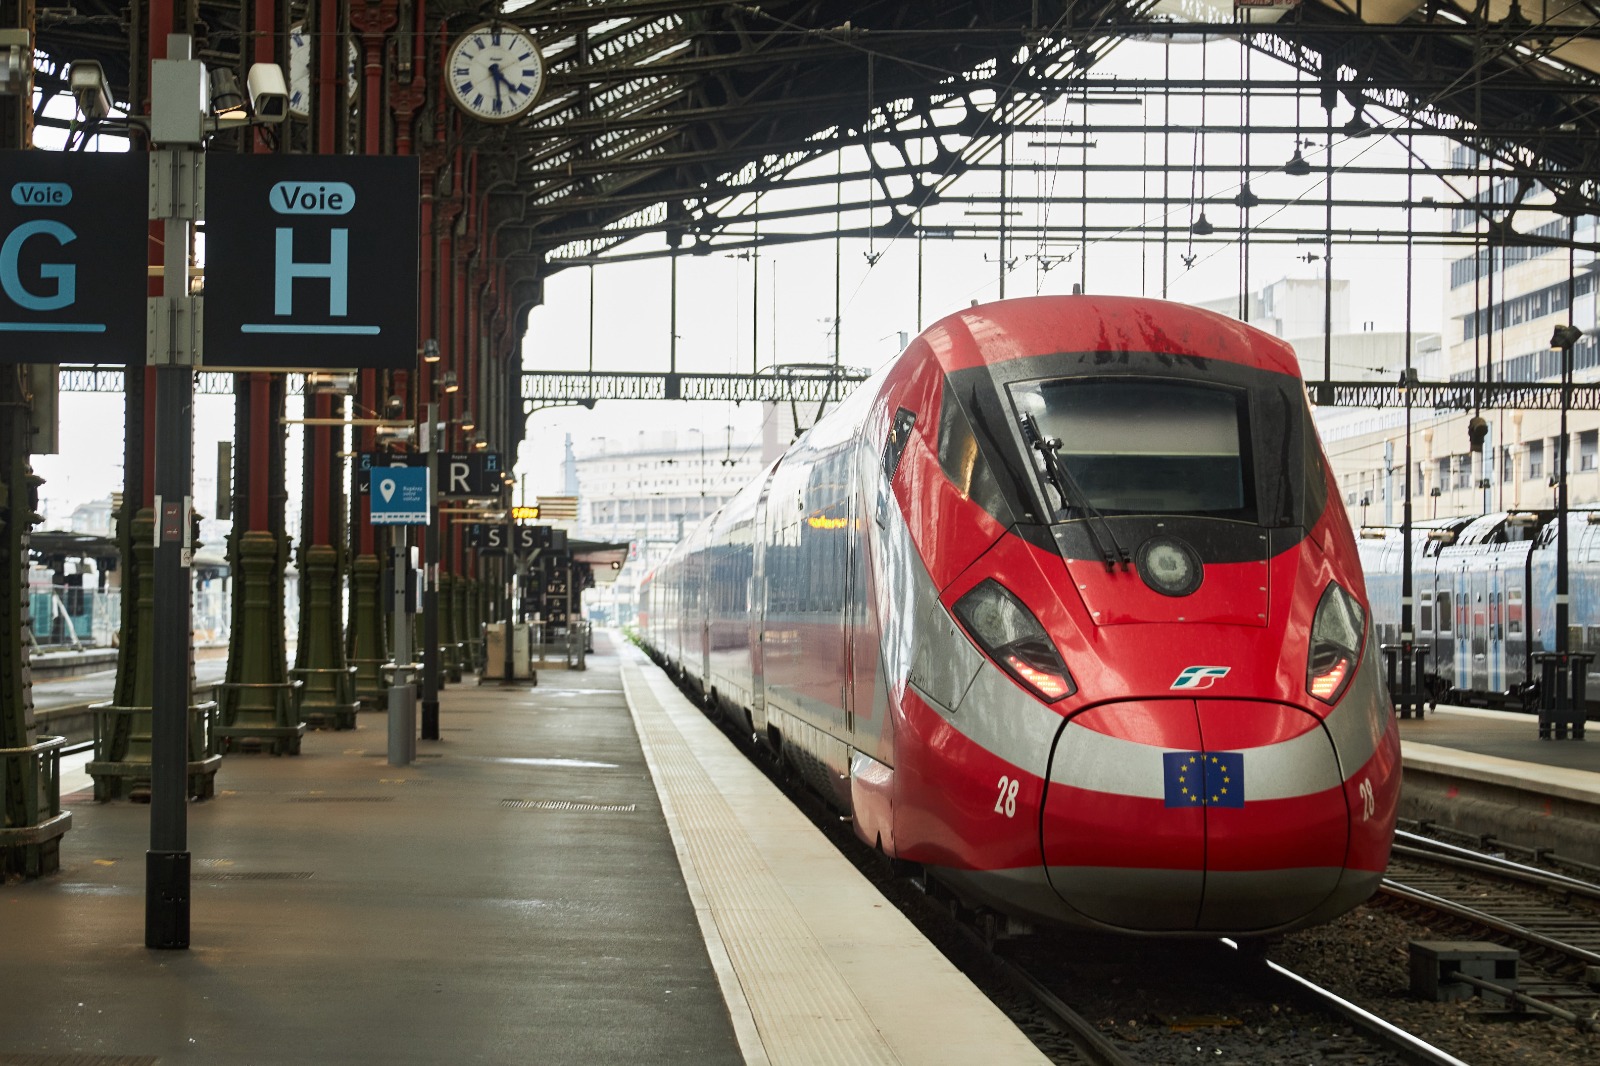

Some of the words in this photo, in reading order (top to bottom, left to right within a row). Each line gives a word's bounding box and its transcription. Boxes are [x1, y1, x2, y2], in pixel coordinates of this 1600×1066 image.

[20, 186, 63, 204] Voie
[279, 186, 343, 210] Voie
[0, 219, 78, 311] G
[274, 227, 349, 316] H
[361, 460, 371, 469] G
[487, 460, 496, 470] H
[450, 462, 471, 493] R
[488, 529, 501, 547] S
[521, 529, 533, 547] S
[994, 775, 1020, 818] 28
[1359, 777, 1375, 822] 28
